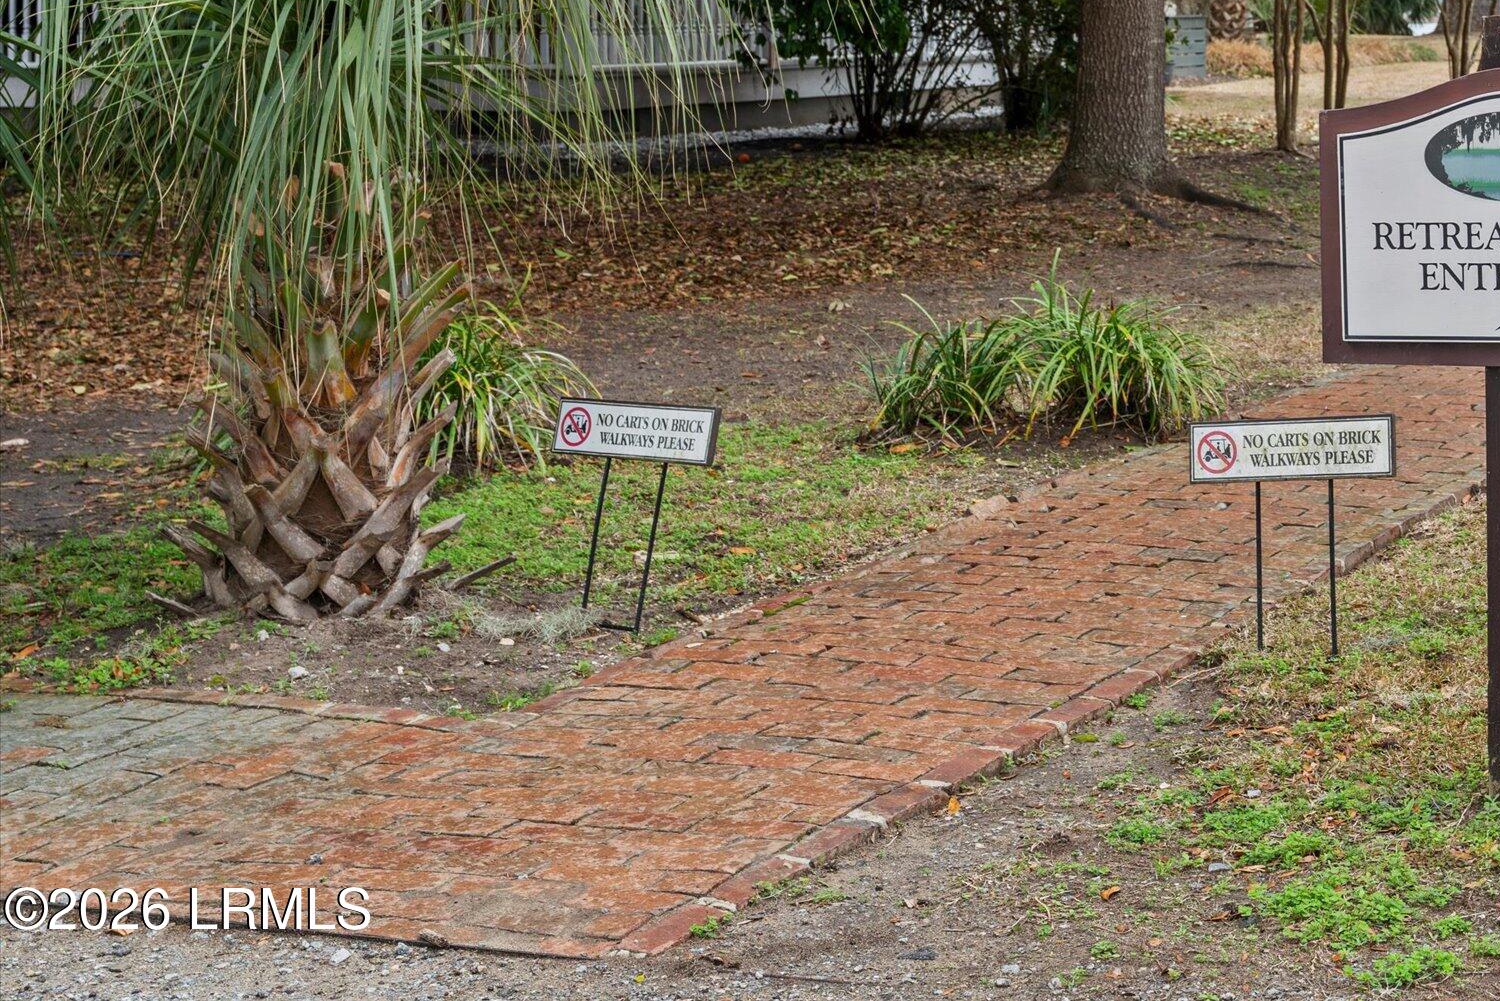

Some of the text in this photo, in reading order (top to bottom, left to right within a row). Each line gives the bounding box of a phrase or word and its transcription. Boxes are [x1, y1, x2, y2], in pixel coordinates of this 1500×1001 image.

[596, 413, 705, 434] NO CARTS ON BRICK
[600, 431, 696, 451] WALKWAYS PLEASE
[1243, 430, 1382, 448] NO CARTS ON BRICK
[1250, 449, 1374, 467] WALKWAYS PLEASE
